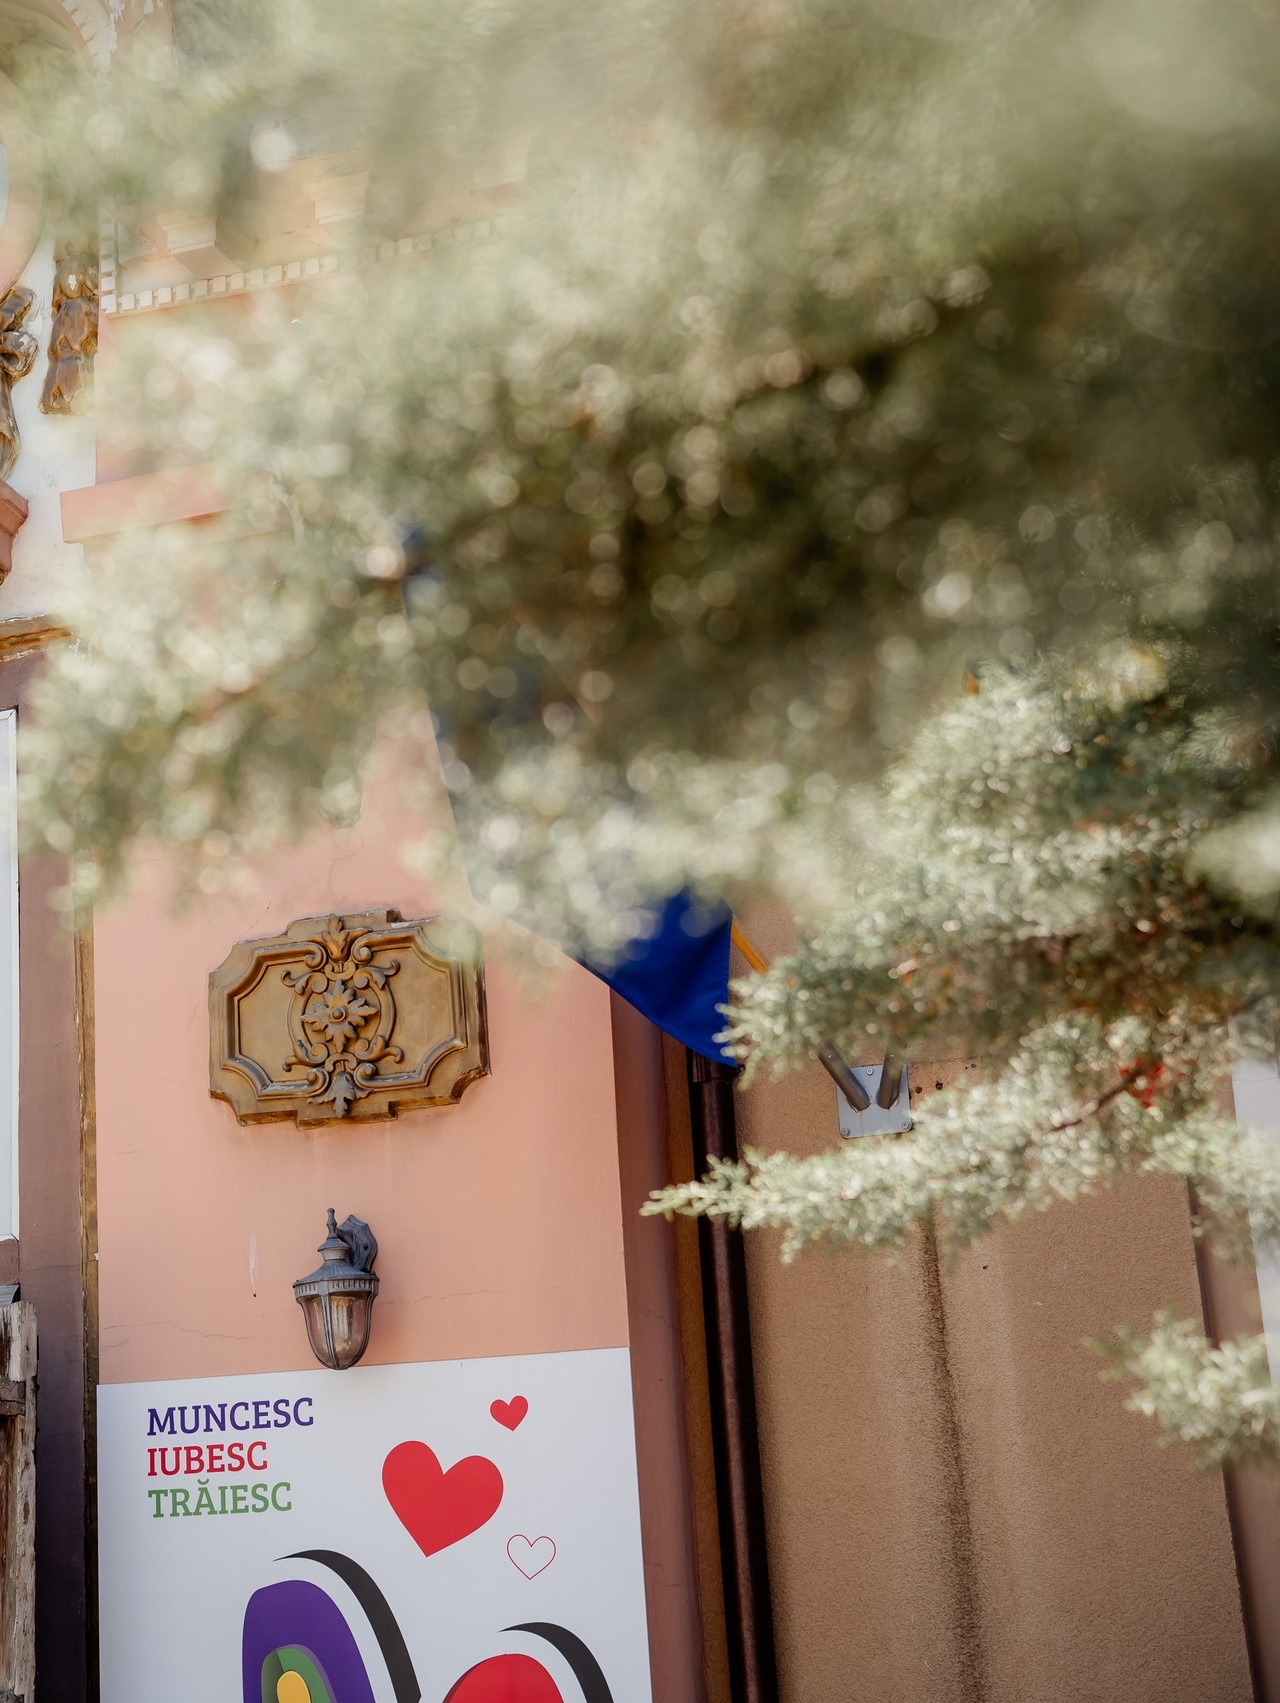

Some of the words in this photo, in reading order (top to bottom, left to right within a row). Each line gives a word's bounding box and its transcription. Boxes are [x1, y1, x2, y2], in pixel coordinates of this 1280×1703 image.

[146, 1396, 315, 1436] MUNCESC
[147, 1440, 268, 1477] IUBESC
[147, 1478, 293, 1519] TRĂIESC
